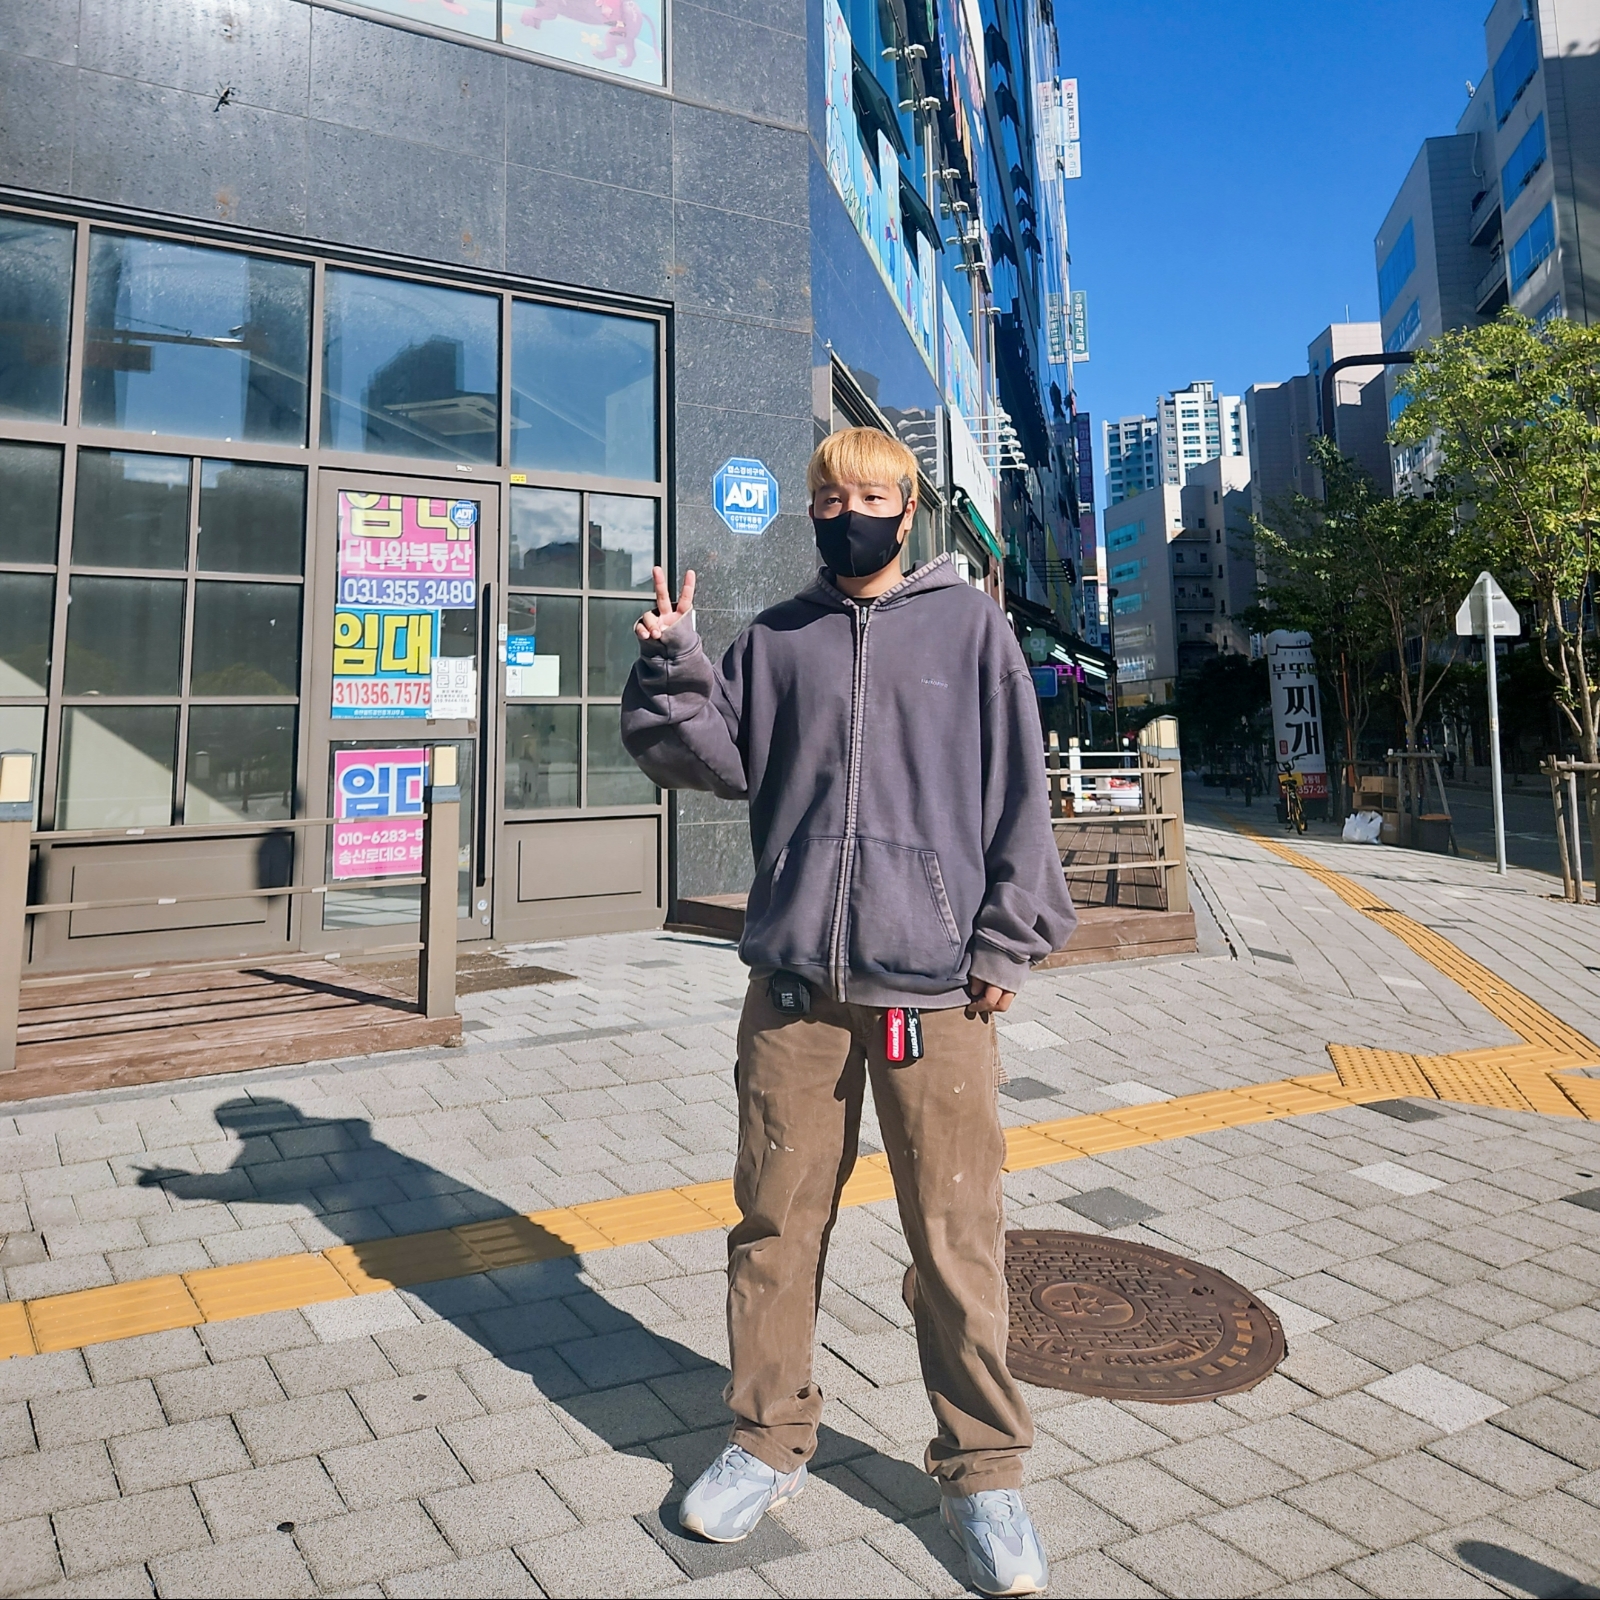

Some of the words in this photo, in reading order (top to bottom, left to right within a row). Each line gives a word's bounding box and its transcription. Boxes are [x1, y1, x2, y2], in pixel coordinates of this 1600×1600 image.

[725, 481, 768, 510] ADT
[455, 508, 473, 520] ADT
[345, 540, 472, 572] 다나와부동산
[344, 578, 476, 605] 031.355.3480
[333, 612, 432, 675] 임대
[1030, 638, 1046, 655] 약
[1283, 685, 1321, 755] 찌개
[338, 846, 406, 866] 송산로데오
[890, 1015, 902, 1059] Supreme
[907, 1016, 919, 1058] Supreme
